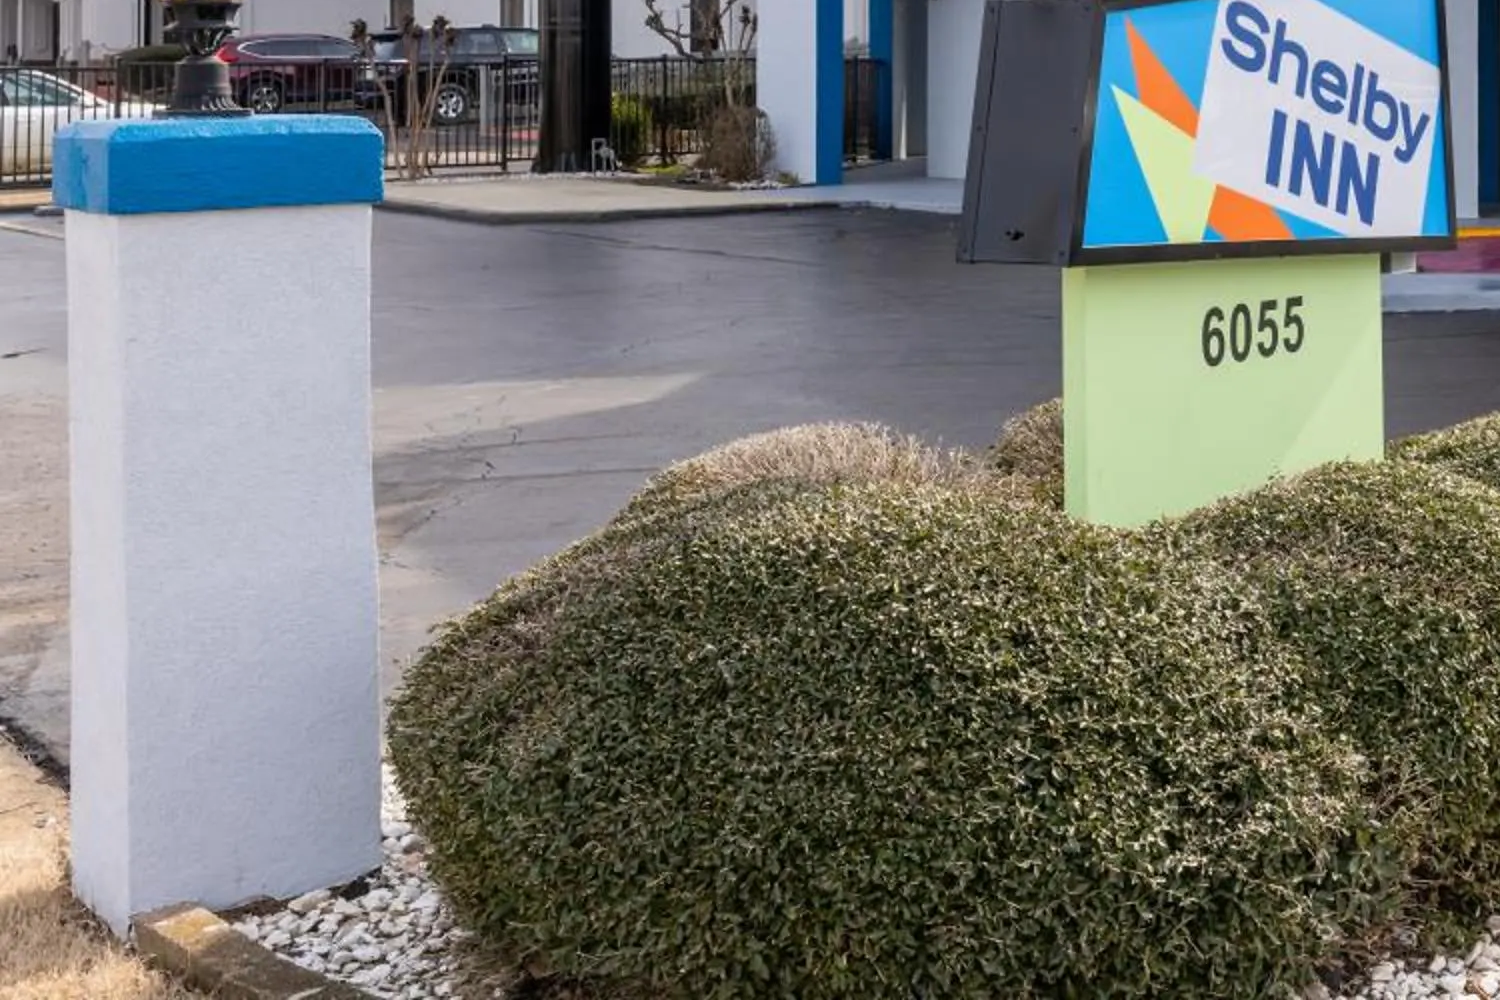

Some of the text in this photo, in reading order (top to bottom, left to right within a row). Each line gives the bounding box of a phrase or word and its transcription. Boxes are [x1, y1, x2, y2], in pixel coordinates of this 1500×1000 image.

[1221, 0, 1430, 164] Shelby
[1265, 109, 1380, 227] INN
[1202, 295, 1305, 367] 6055
